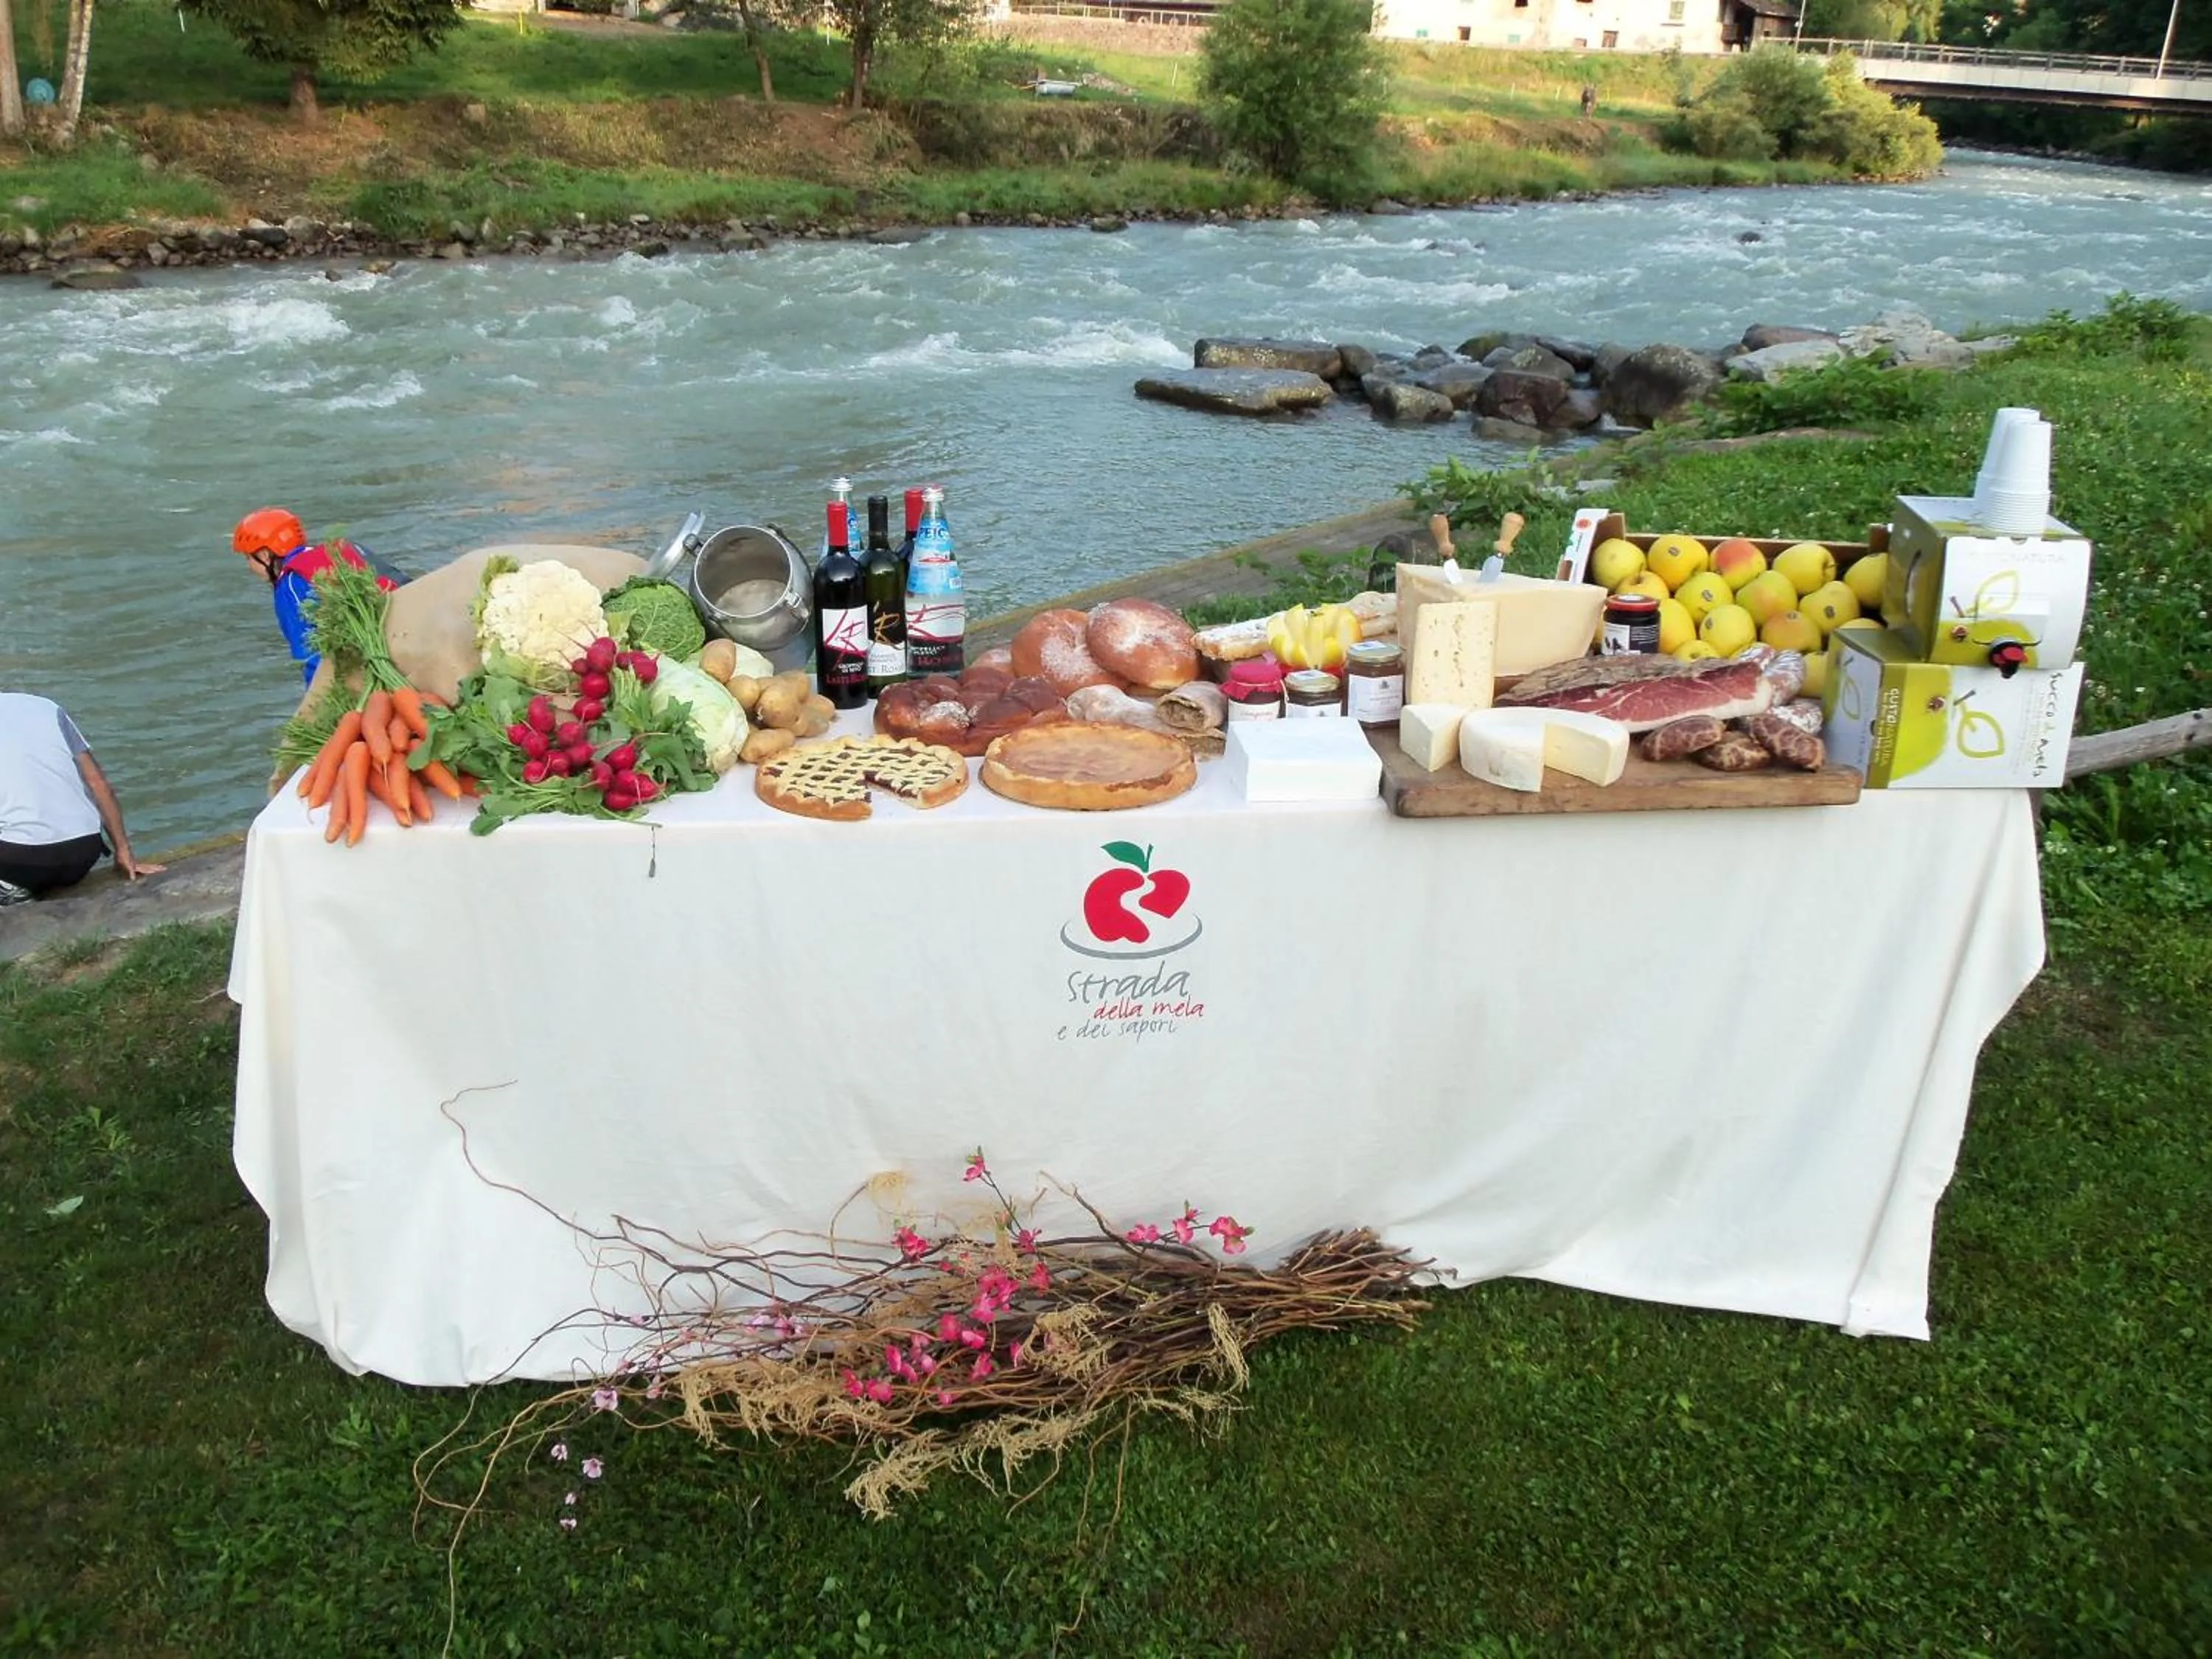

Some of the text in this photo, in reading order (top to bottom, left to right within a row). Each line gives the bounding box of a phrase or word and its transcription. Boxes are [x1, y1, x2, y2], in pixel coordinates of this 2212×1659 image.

[1068, 960, 1191, 1004] Strada
[1093, 995, 1205, 1020] della mela
[1057, 1019, 1178, 1044] e dei sapori
